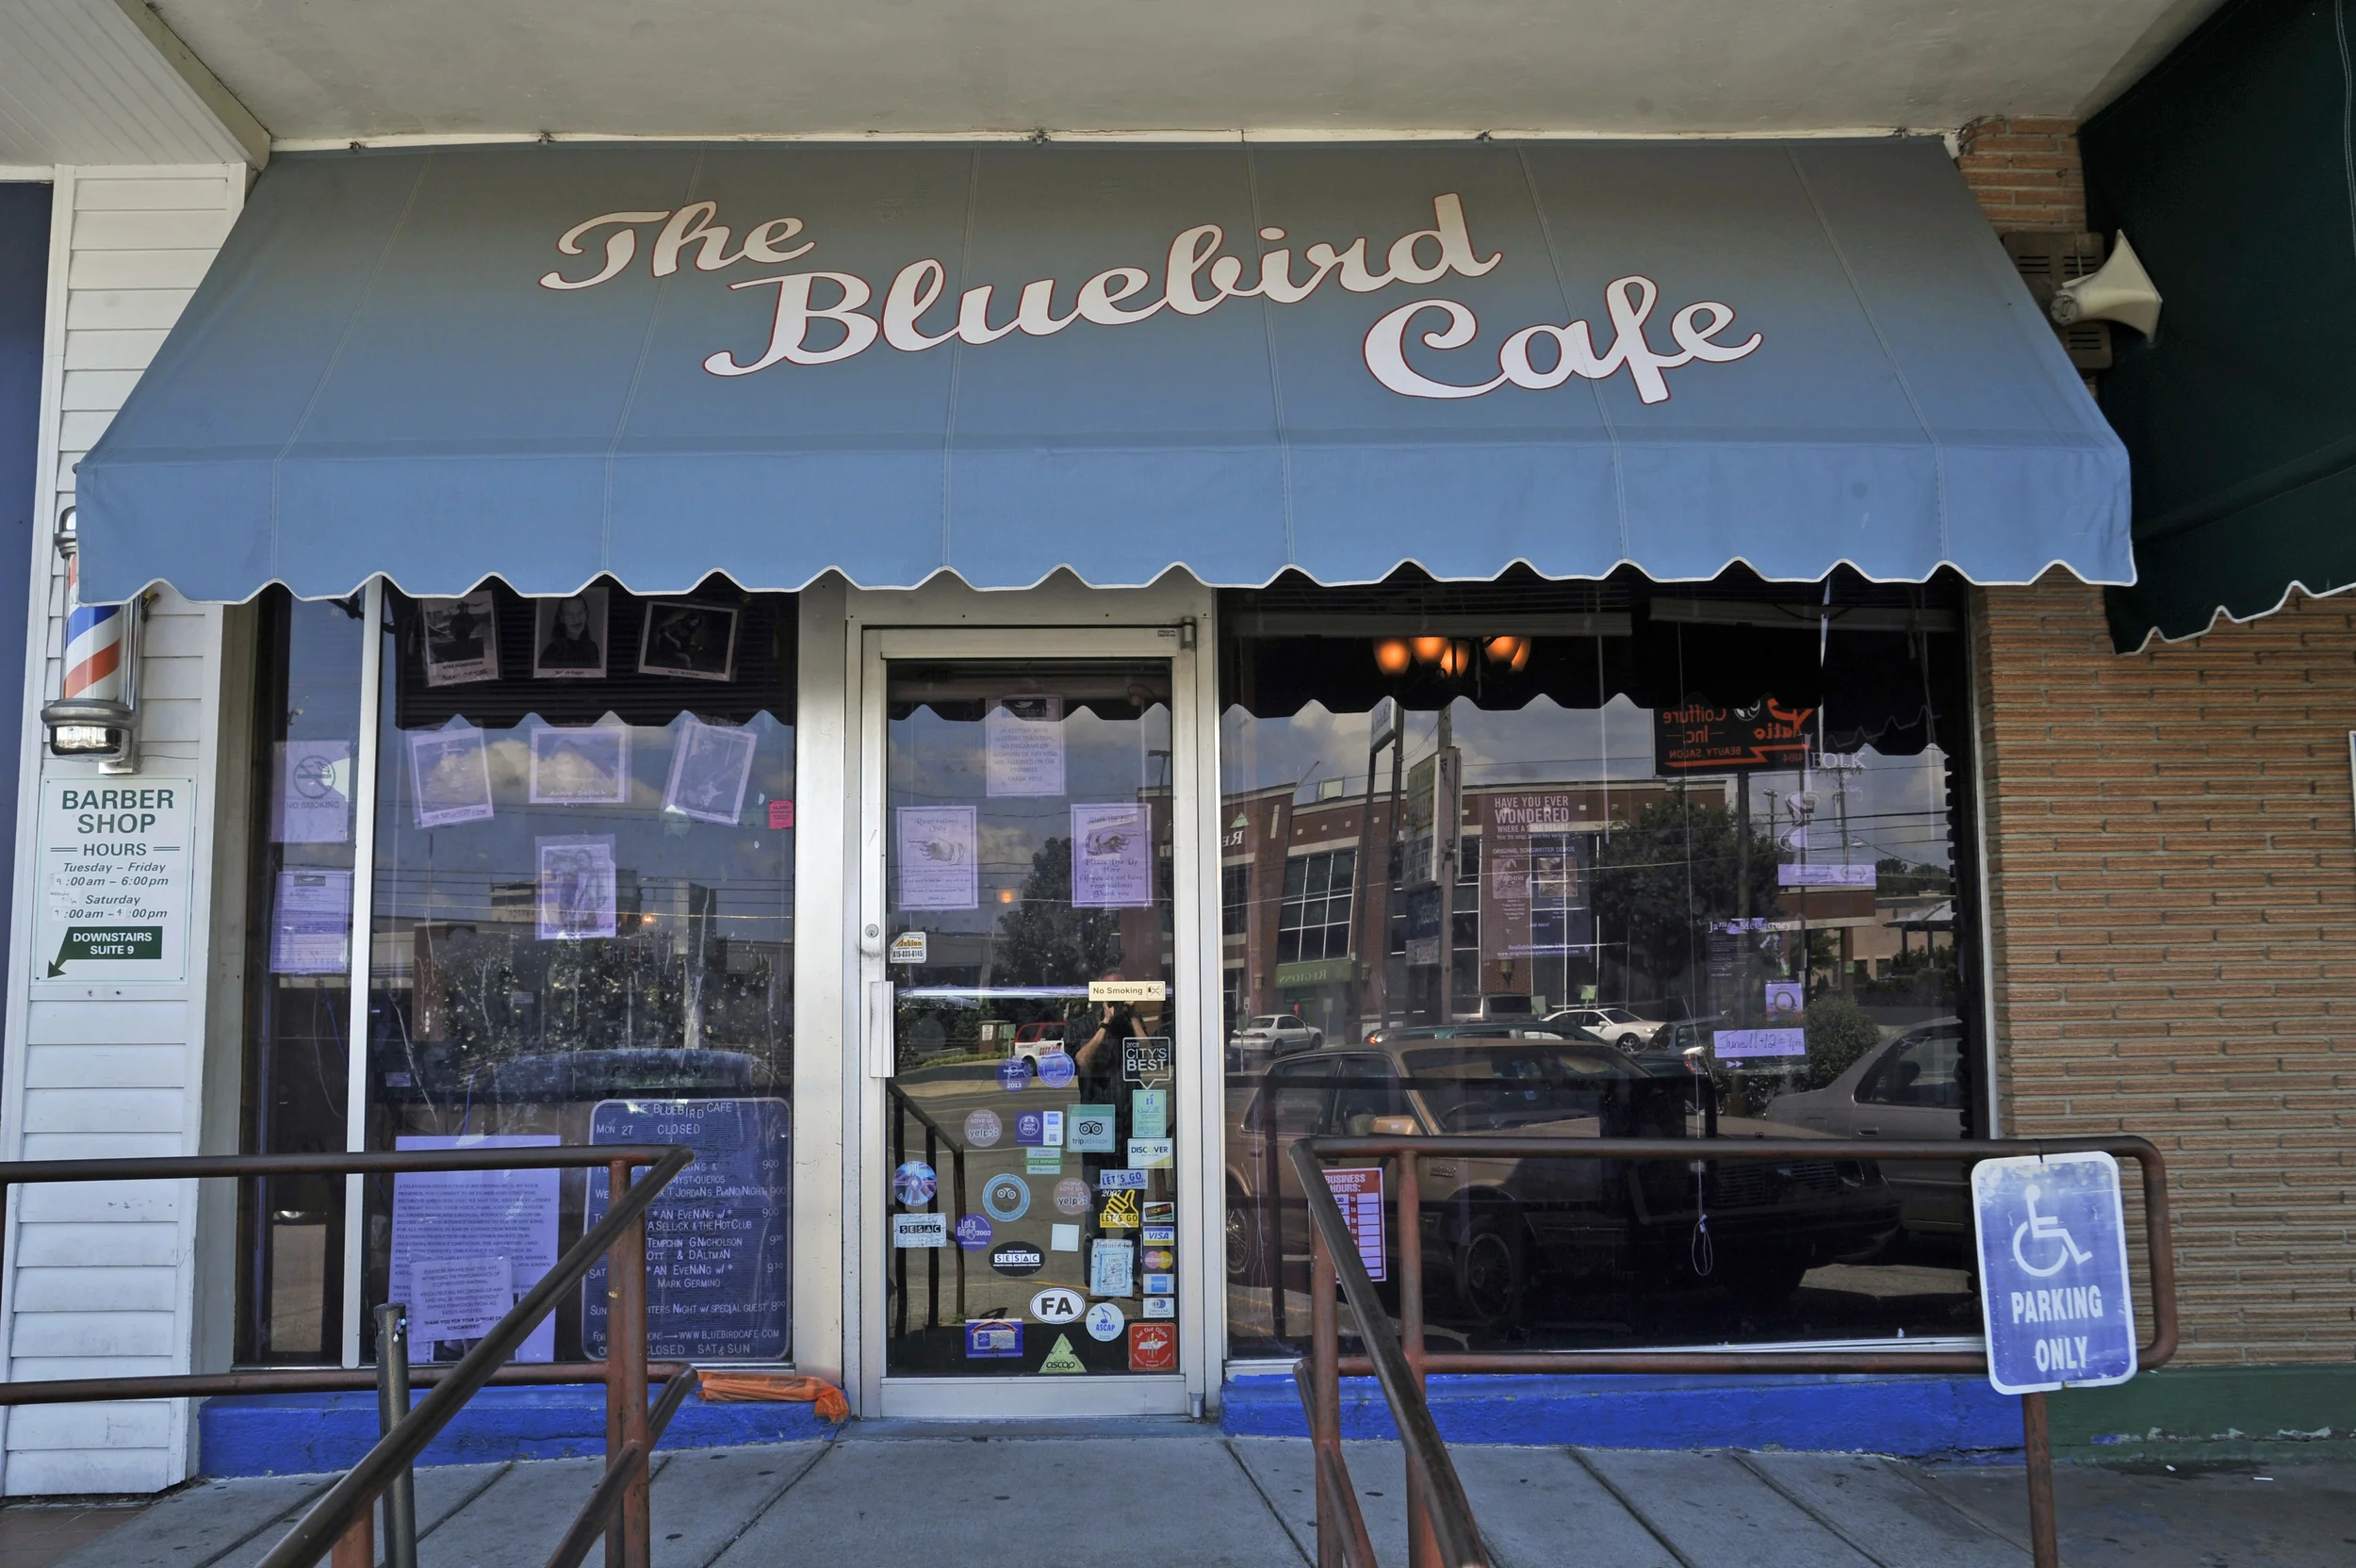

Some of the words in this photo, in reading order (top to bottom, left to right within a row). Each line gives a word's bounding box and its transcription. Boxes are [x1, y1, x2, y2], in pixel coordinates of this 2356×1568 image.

[538, 200, 817, 291] The
[703, 192, 1502, 377] Bluebird
[1363, 275, 1763, 405] Cafe
[62, 789, 174, 810] BARBER
[301, 801, 340, 809] SMOKING
[1495, 797, 1518, 808] HAVE
[1521, 796, 1542, 808] YOU
[1545, 795, 1569, 807] EVER
[914, 818, 958, 826] Reservations
[1495, 807, 1570, 825] WONDERED
[77, 813, 156, 834] SHOP
[1497, 825, 1519, 833] WHERE
[1527, 824, 1545, 833] SONG
[83, 842, 147, 857] HOURS
[64, 862, 112, 874] Tuesday
[128, 861, 166, 874] Friday
[1110, 858, 1124, 867] Line
[1126, 858, 1138, 867] Up
[85, 894, 140, 906] Saturday
[1708, 921, 1737, 934] James
[1740, 921, 1792, 931] McCartney
[73, 932, 153, 942] DOWNSTAIRS
[896, 938, 923, 947] Action
[90, 945, 123, 955] SUITE
[126, 945, 135, 955] 9
[1093, 987, 1106, 995] No
[1108, 987, 1143, 996] Smoking
[1715, 1030, 1748, 1050] June
[1126, 1048, 1168, 1059] CITY'S
[1127, 1059, 1168, 1071] BEST
[653, 1104, 704, 1119] BLUEBIRD
[707, 1102, 732, 1113] CAFE
[597, 1124, 615, 1135] MON
[621, 1125, 633, 1135] 27
[657, 1124, 701, 1135] CLOSED
[969, 1127, 990, 1139] yelp
[1072, 1137, 1108, 1146] tripadvisor
[712, 1163, 717, 1171] &
[1102, 1174, 1126, 1186] LET'S
[1129, 1172, 1142, 1182] GO
[1325, 1173, 1366, 1184] BUSINESS
[675, 1187, 712, 1198] JORDANS
[716, 1186, 741, 1197] PIANO
[742, 1186, 766, 1197] NIGHT
[1330, 1184, 1361, 1193] HOURS:
[1058, 1197, 1078, 1207] yelp
[660, 1210, 674, 1219] AN
[678, 1209, 714, 1219] EVENING
[1102, 1214, 1123, 1223] LET'S
[1126, 1214, 1138, 1223] GO
[699, 1221, 713, 1230] THE
[714, 1219, 729, 1230] HOT
[731, 1218, 752, 1230] CLUB
[961, 1218, 976, 1229] Let's
[1149, 1232, 1170, 1240] VISA
[647, 1237, 683, 1249] TEMPCHIN
[646, 1250, 664, 1261] OTT
[677, 1250, 684, 1260] &
[589, 1268, 607, 1279] SAT
[654, 1265, 667, 1275] AN
[673, 1264, 712, 1275] EVENING
[658, 1278, 681, 1289] MARK
[684, 1277, 722, 1288] GERMINO
[590, 1305, 607, 1315] SUN
[673, 1303, 697, 1314] NIGHT
[711, 1303, 741, 1314] SPECIAL
[744, 1302, 767, 1313] GUEST
[1041, 1297, 1074, 1315] FA
[2010, 1284, 2103, 1324] PARKING
[1095, 1323, 1117, 1332] ASCAP
[593, 1331, 607, 1342] FOR
[697, 1344, 717, 1354] SAT
[728, 1343, 750, 1354] SUN
[2035, 1336, 2088, 1372] ONLY
[1046, 1361, 1076, 1370] ascap
